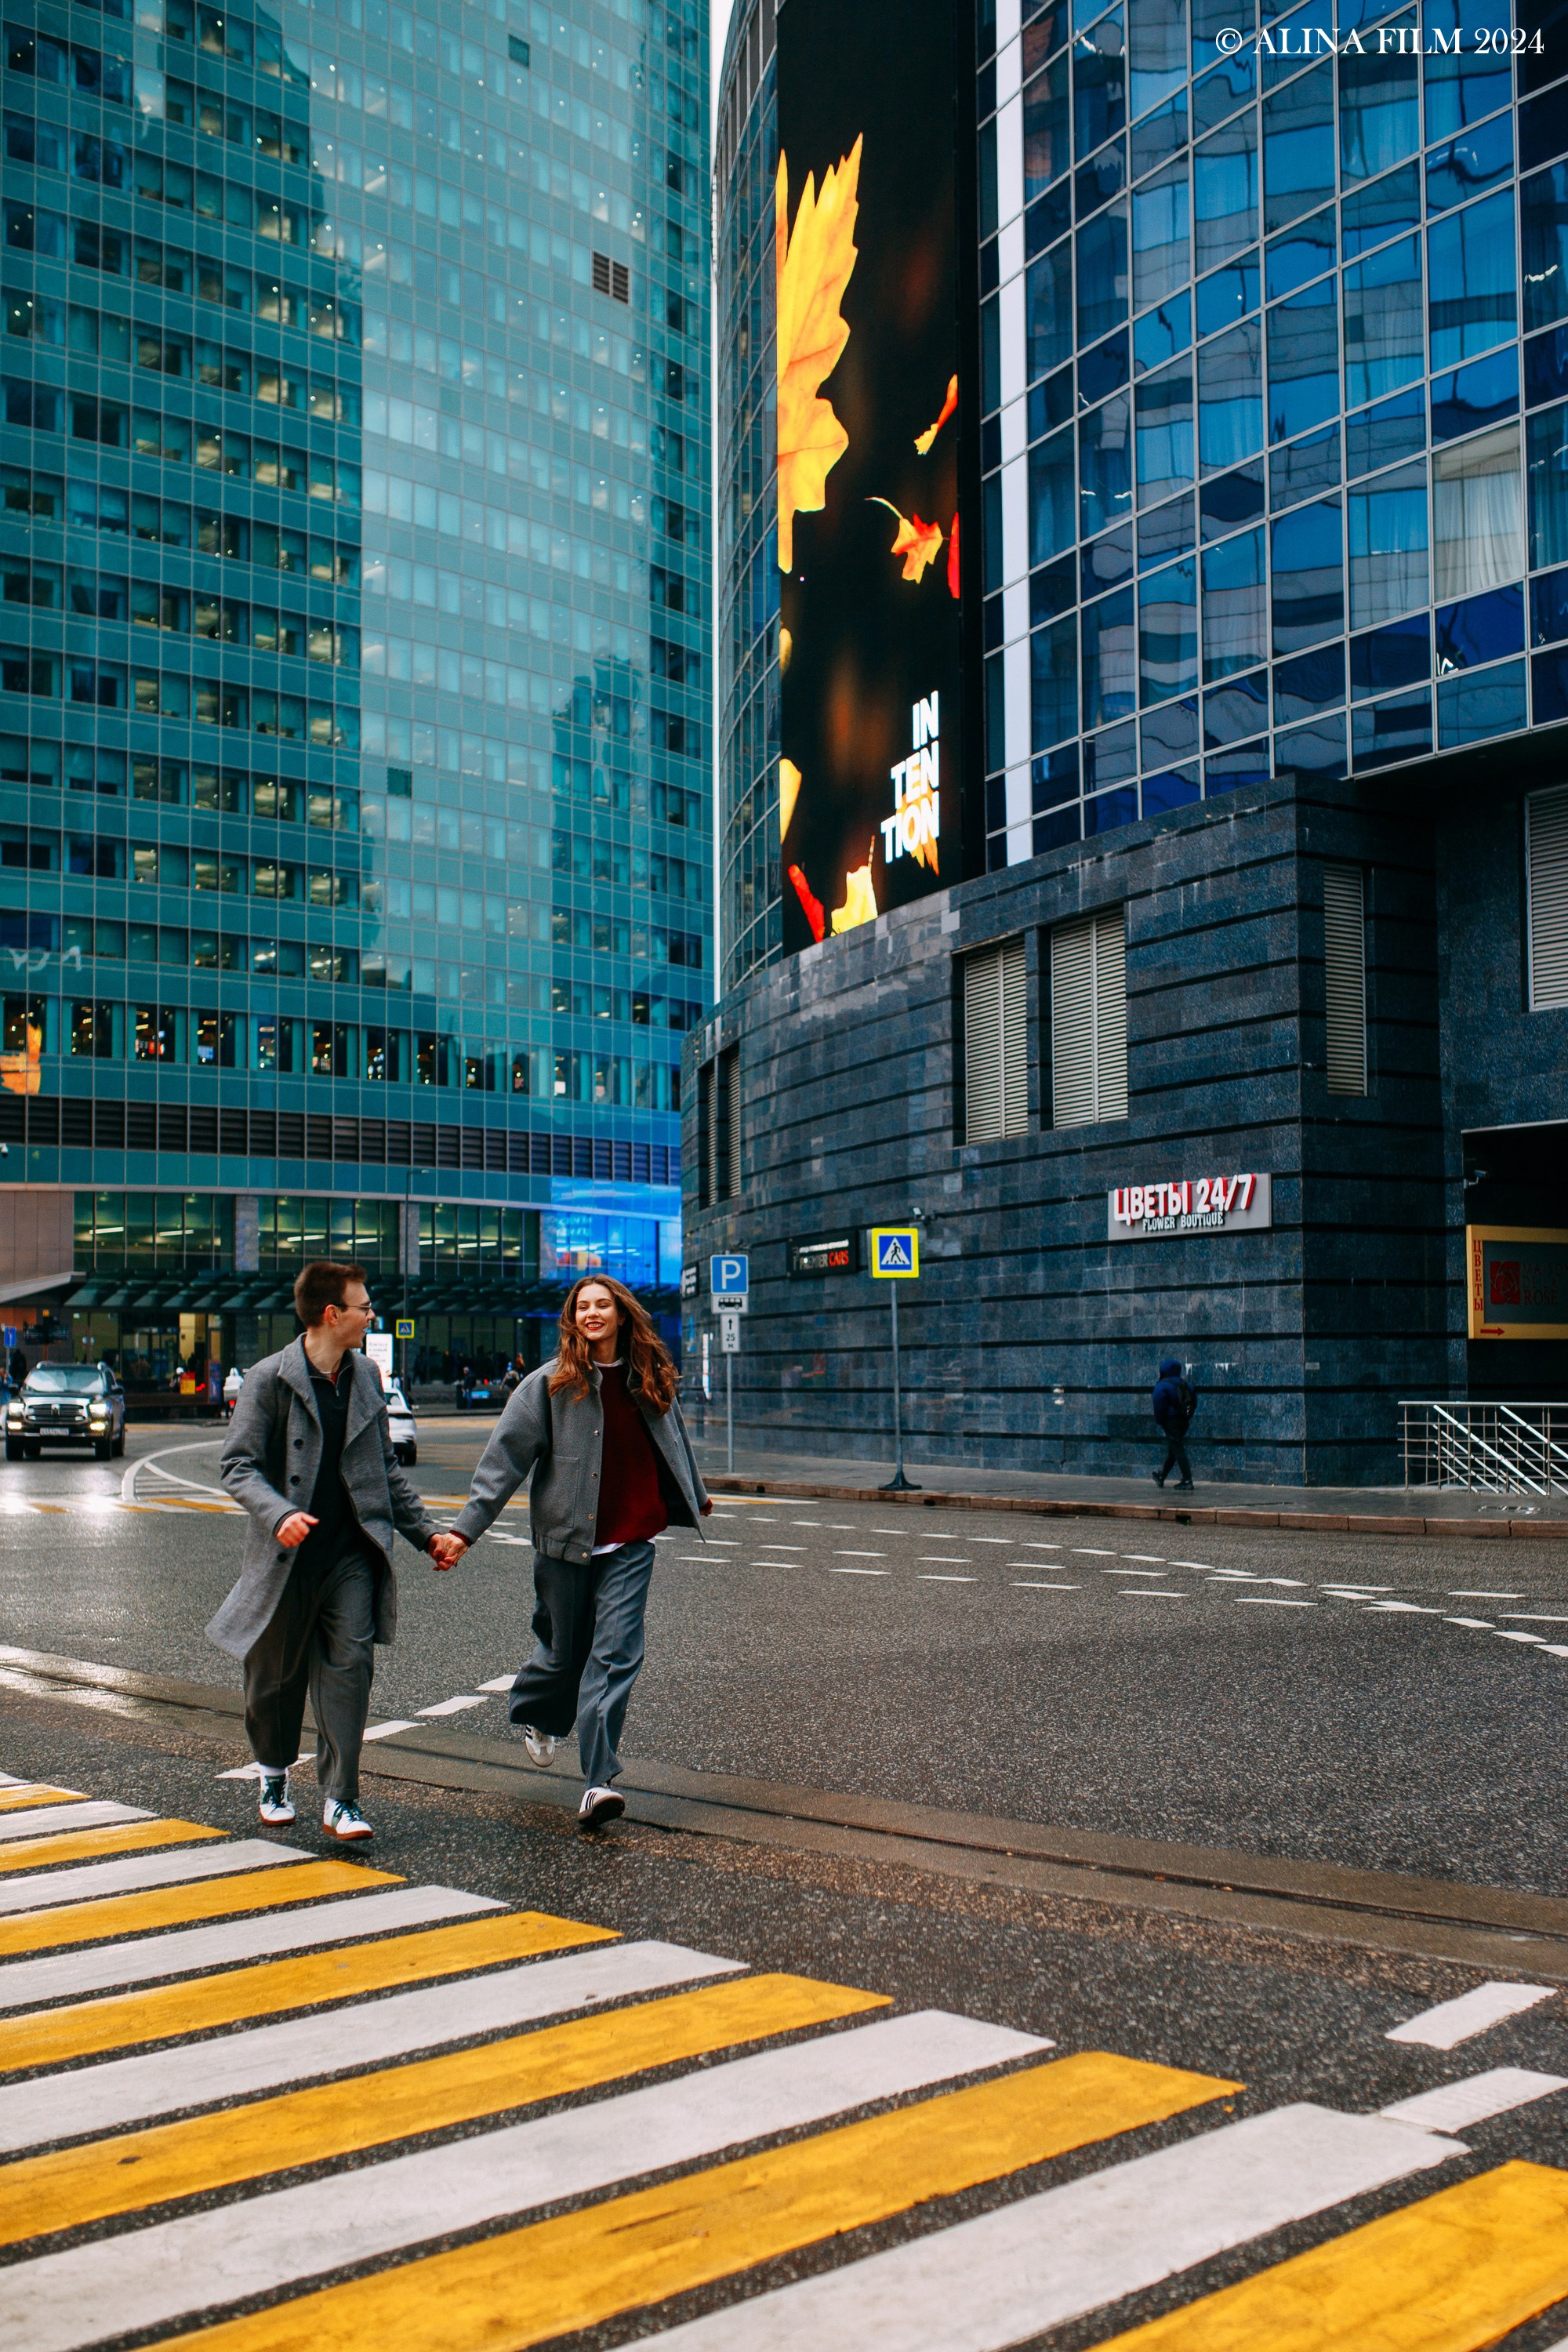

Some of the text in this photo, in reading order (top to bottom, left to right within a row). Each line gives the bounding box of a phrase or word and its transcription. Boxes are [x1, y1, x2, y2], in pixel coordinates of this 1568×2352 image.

[913, 690, 939, 750] IN
[891, 740, 939, 809] TEN
[880, 790, 940, 864] TION
[1114, 1174, 1256, 1226] ЦВЕТЫ 24/7
[1142, 1211, 1225, 1232] FLOWER BOUTIQUE
[721, 1260, 741, 1289] P
[828, 1249, 849, 1267] CARS
[1473, 1240, 1483, 1311] ЦВЕТЫ
[1523, 1290, 1559, 1306] ROSE
